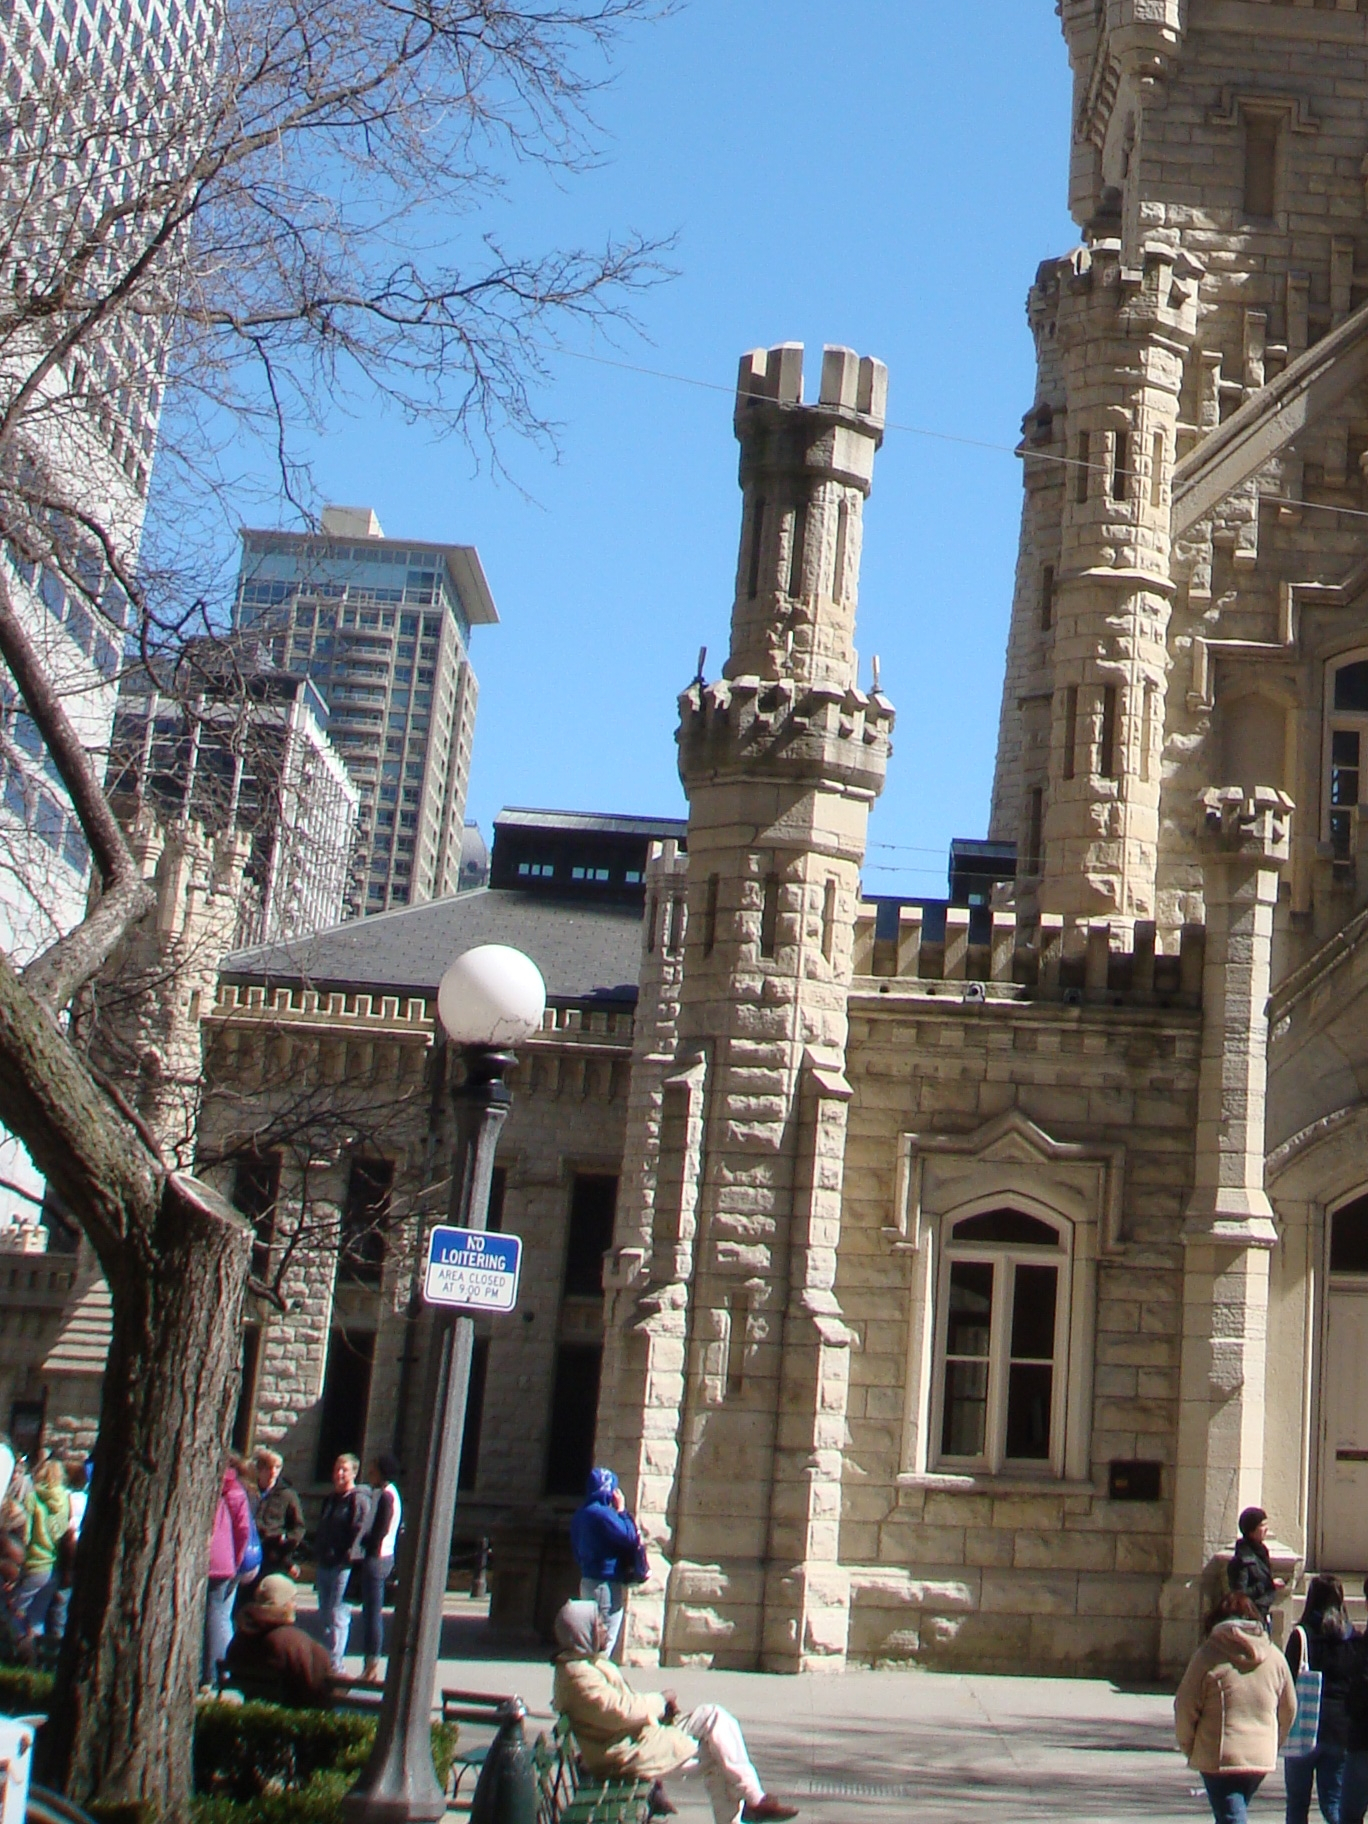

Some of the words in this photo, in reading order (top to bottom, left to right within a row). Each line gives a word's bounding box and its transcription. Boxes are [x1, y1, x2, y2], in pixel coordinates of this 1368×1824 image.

[467, 1236, 485, 1251] NO
[442, 1248, 506, 1270] LOITERING
[438, 1269, 464, 1282] AREA
[469, 1273, 506, 1287] CLOSED
[442, 1282, 453, 1293] AT
[485, 1287, 499, 1298] PM
